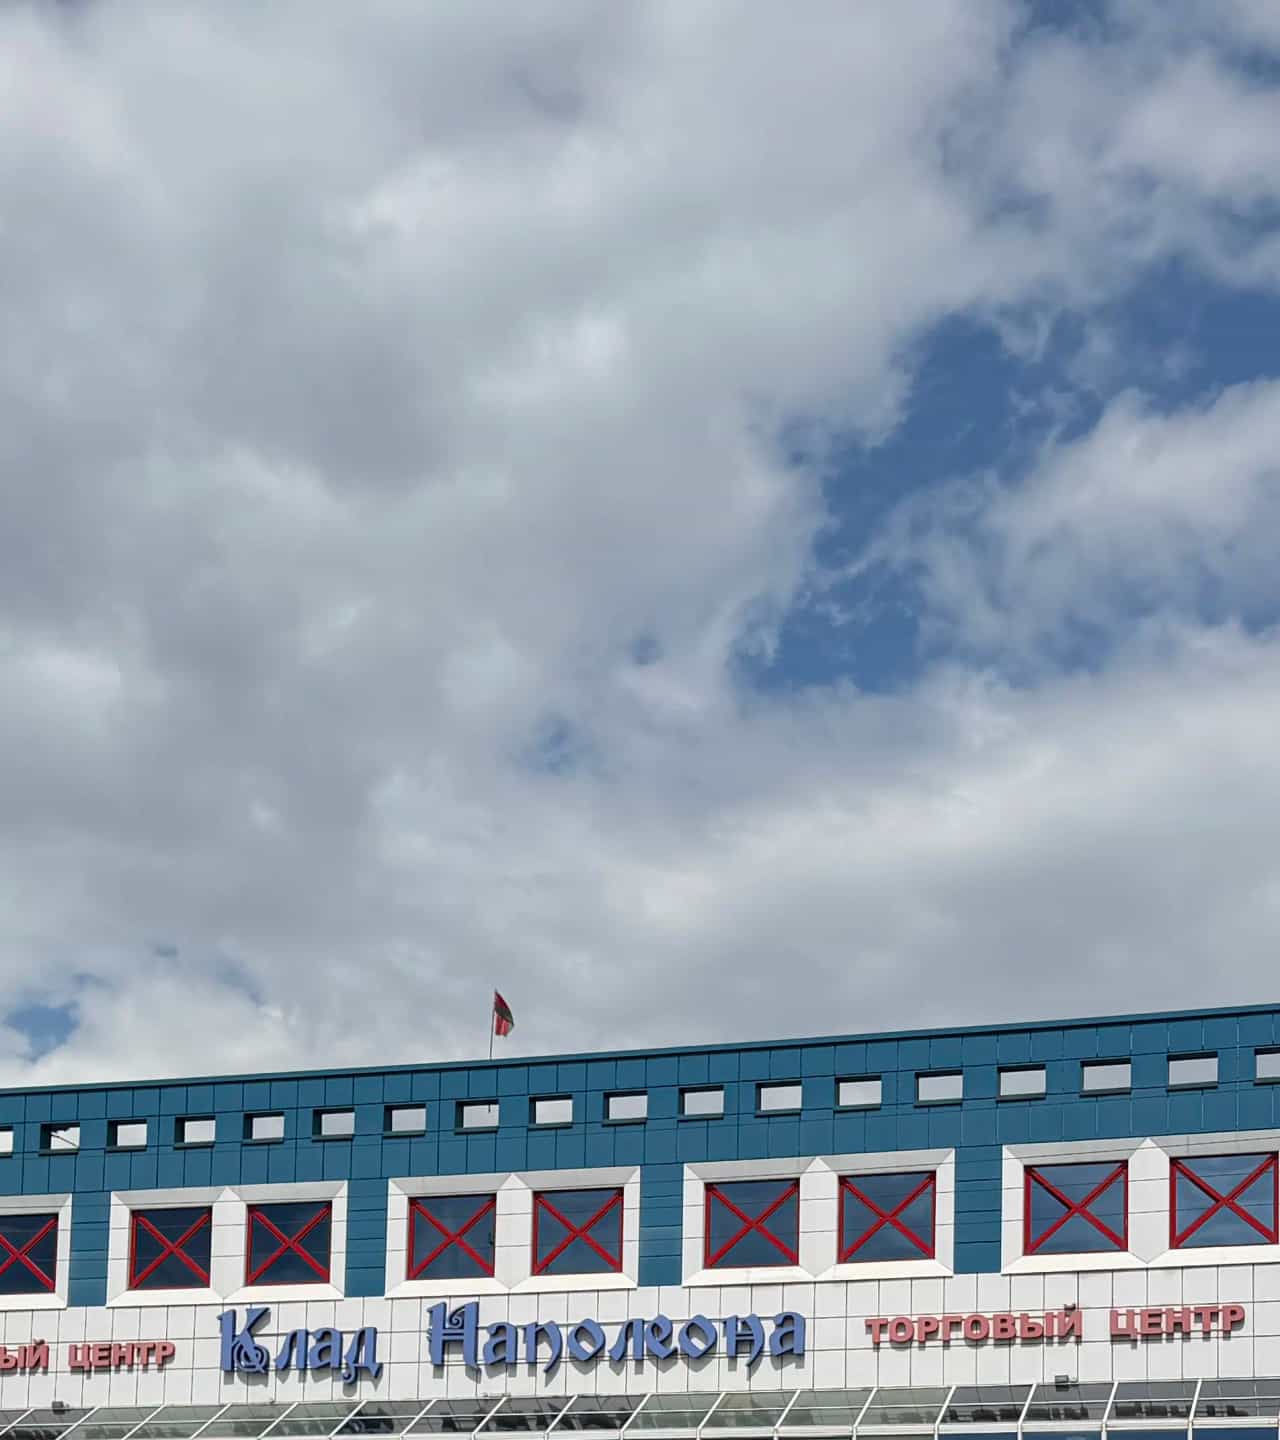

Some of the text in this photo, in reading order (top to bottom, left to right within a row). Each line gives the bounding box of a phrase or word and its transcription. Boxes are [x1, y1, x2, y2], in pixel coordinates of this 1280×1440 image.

[217, 1301, 807, 1384] Клад Наполеона
[865, 1303, 1246, 1344] ТОРГОВЫЙ ЦЕНТР
[68, 1341, 177, 1373] ЦЕНТР
